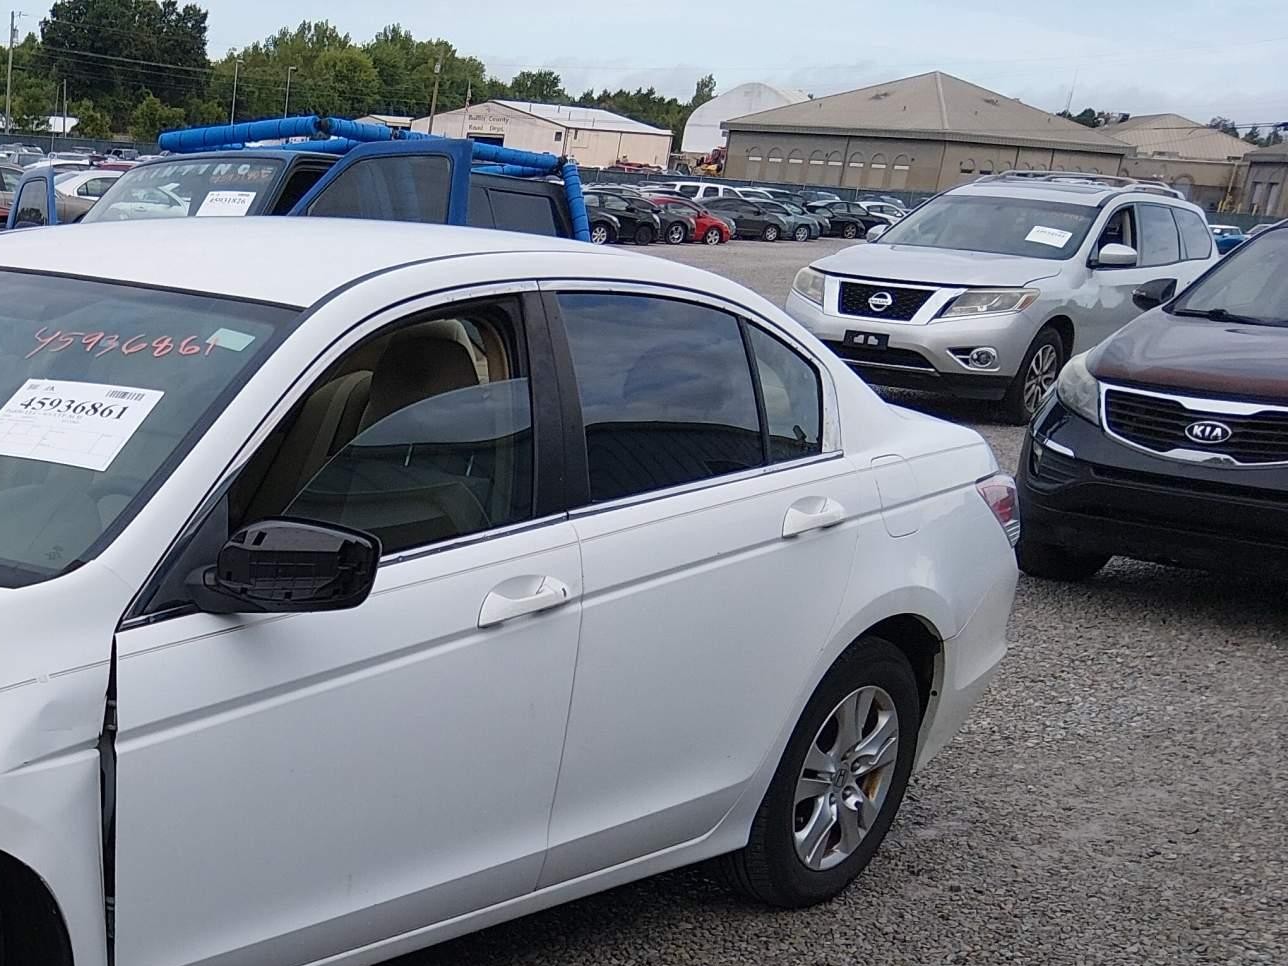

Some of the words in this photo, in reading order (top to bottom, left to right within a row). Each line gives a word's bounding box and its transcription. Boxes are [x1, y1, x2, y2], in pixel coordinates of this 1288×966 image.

[488, 115, 509, 124] County
[25, 327, 218, 359] 45936861
[20, 396, 129, 420] 45936861
[1192, 424, 1222, 440] KIA
